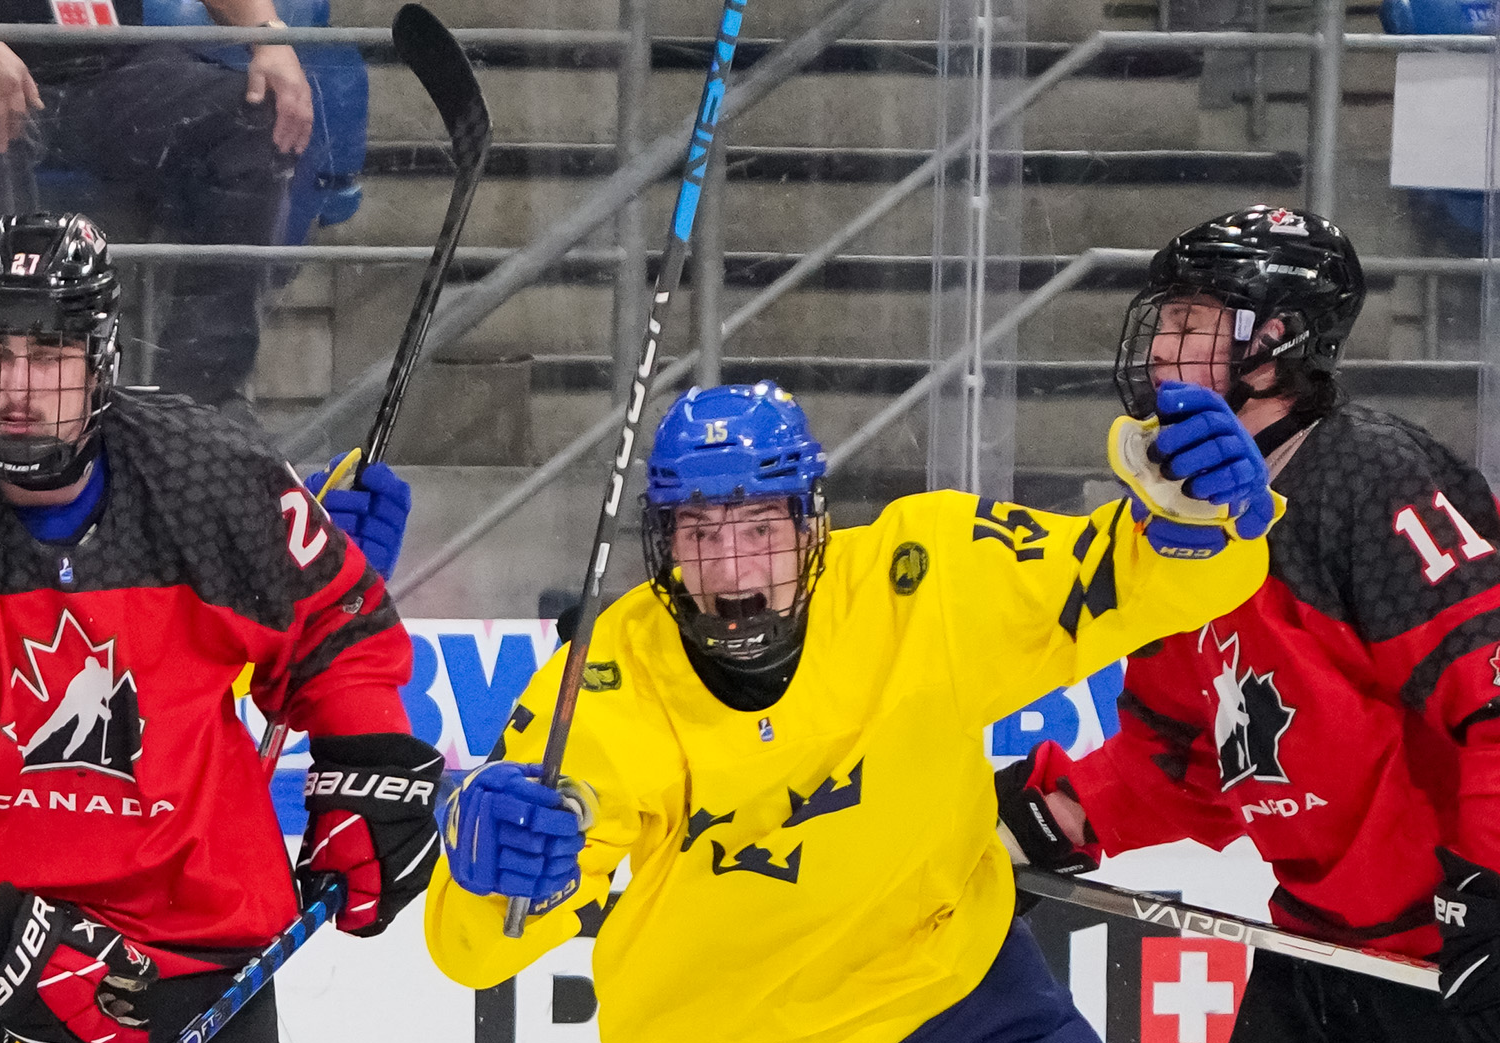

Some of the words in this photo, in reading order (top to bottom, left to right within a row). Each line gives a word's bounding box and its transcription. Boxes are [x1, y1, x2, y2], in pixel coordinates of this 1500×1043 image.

[10, 252, 41, 276] 27
[703, 420, 729, 444] 15
[1395, 491, 1496, 585] 11
